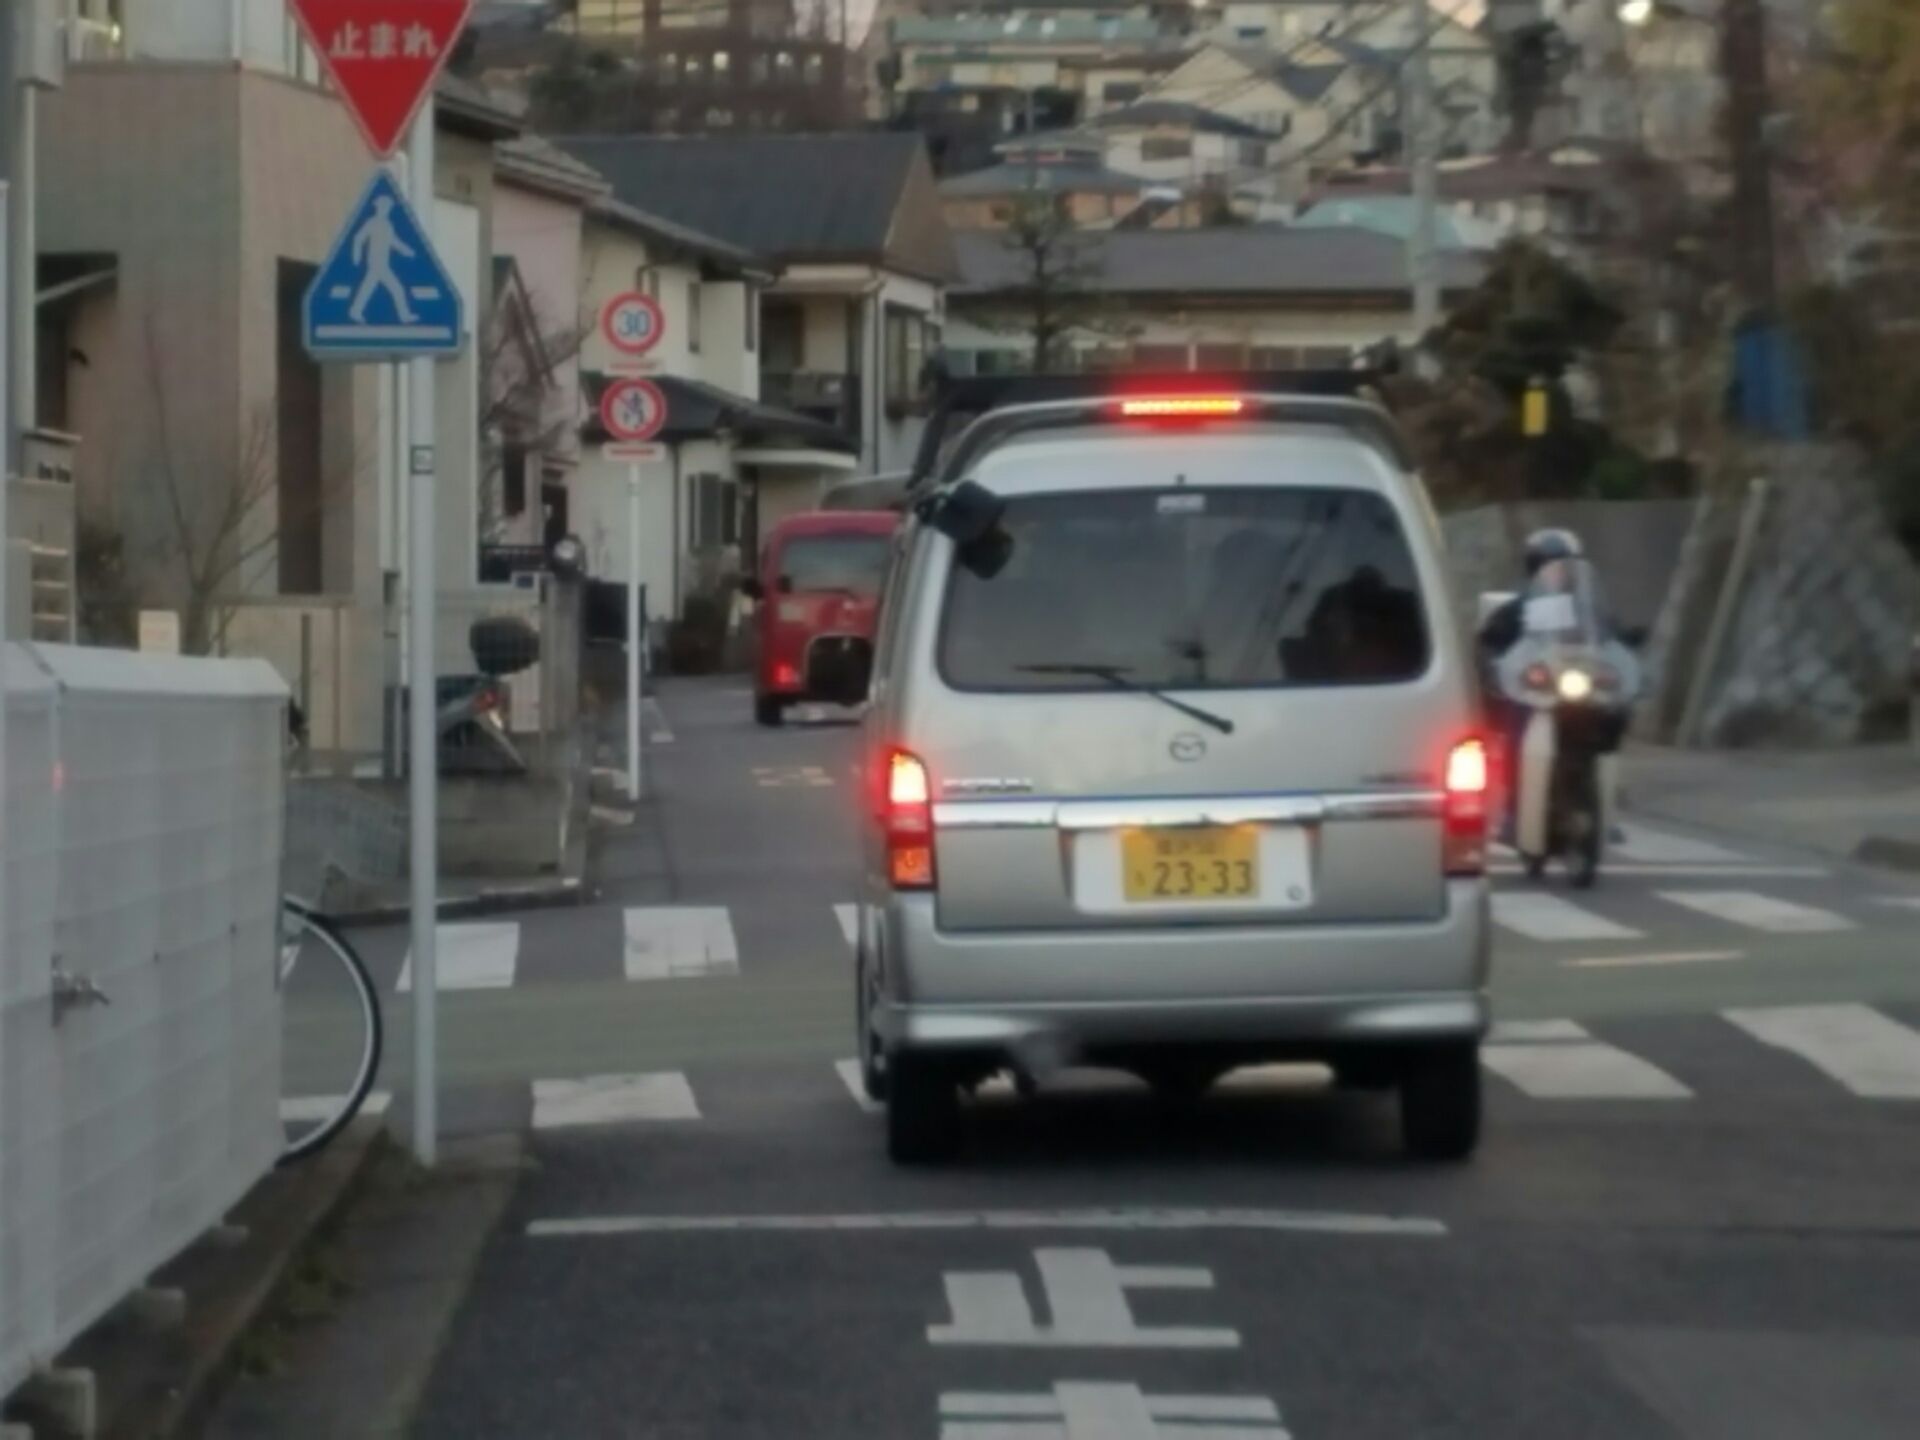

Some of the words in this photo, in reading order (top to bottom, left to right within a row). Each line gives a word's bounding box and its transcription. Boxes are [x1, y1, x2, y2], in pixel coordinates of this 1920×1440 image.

[330, 20, 438, 58] 止まれ
[616, 309, 651, 337] 30
